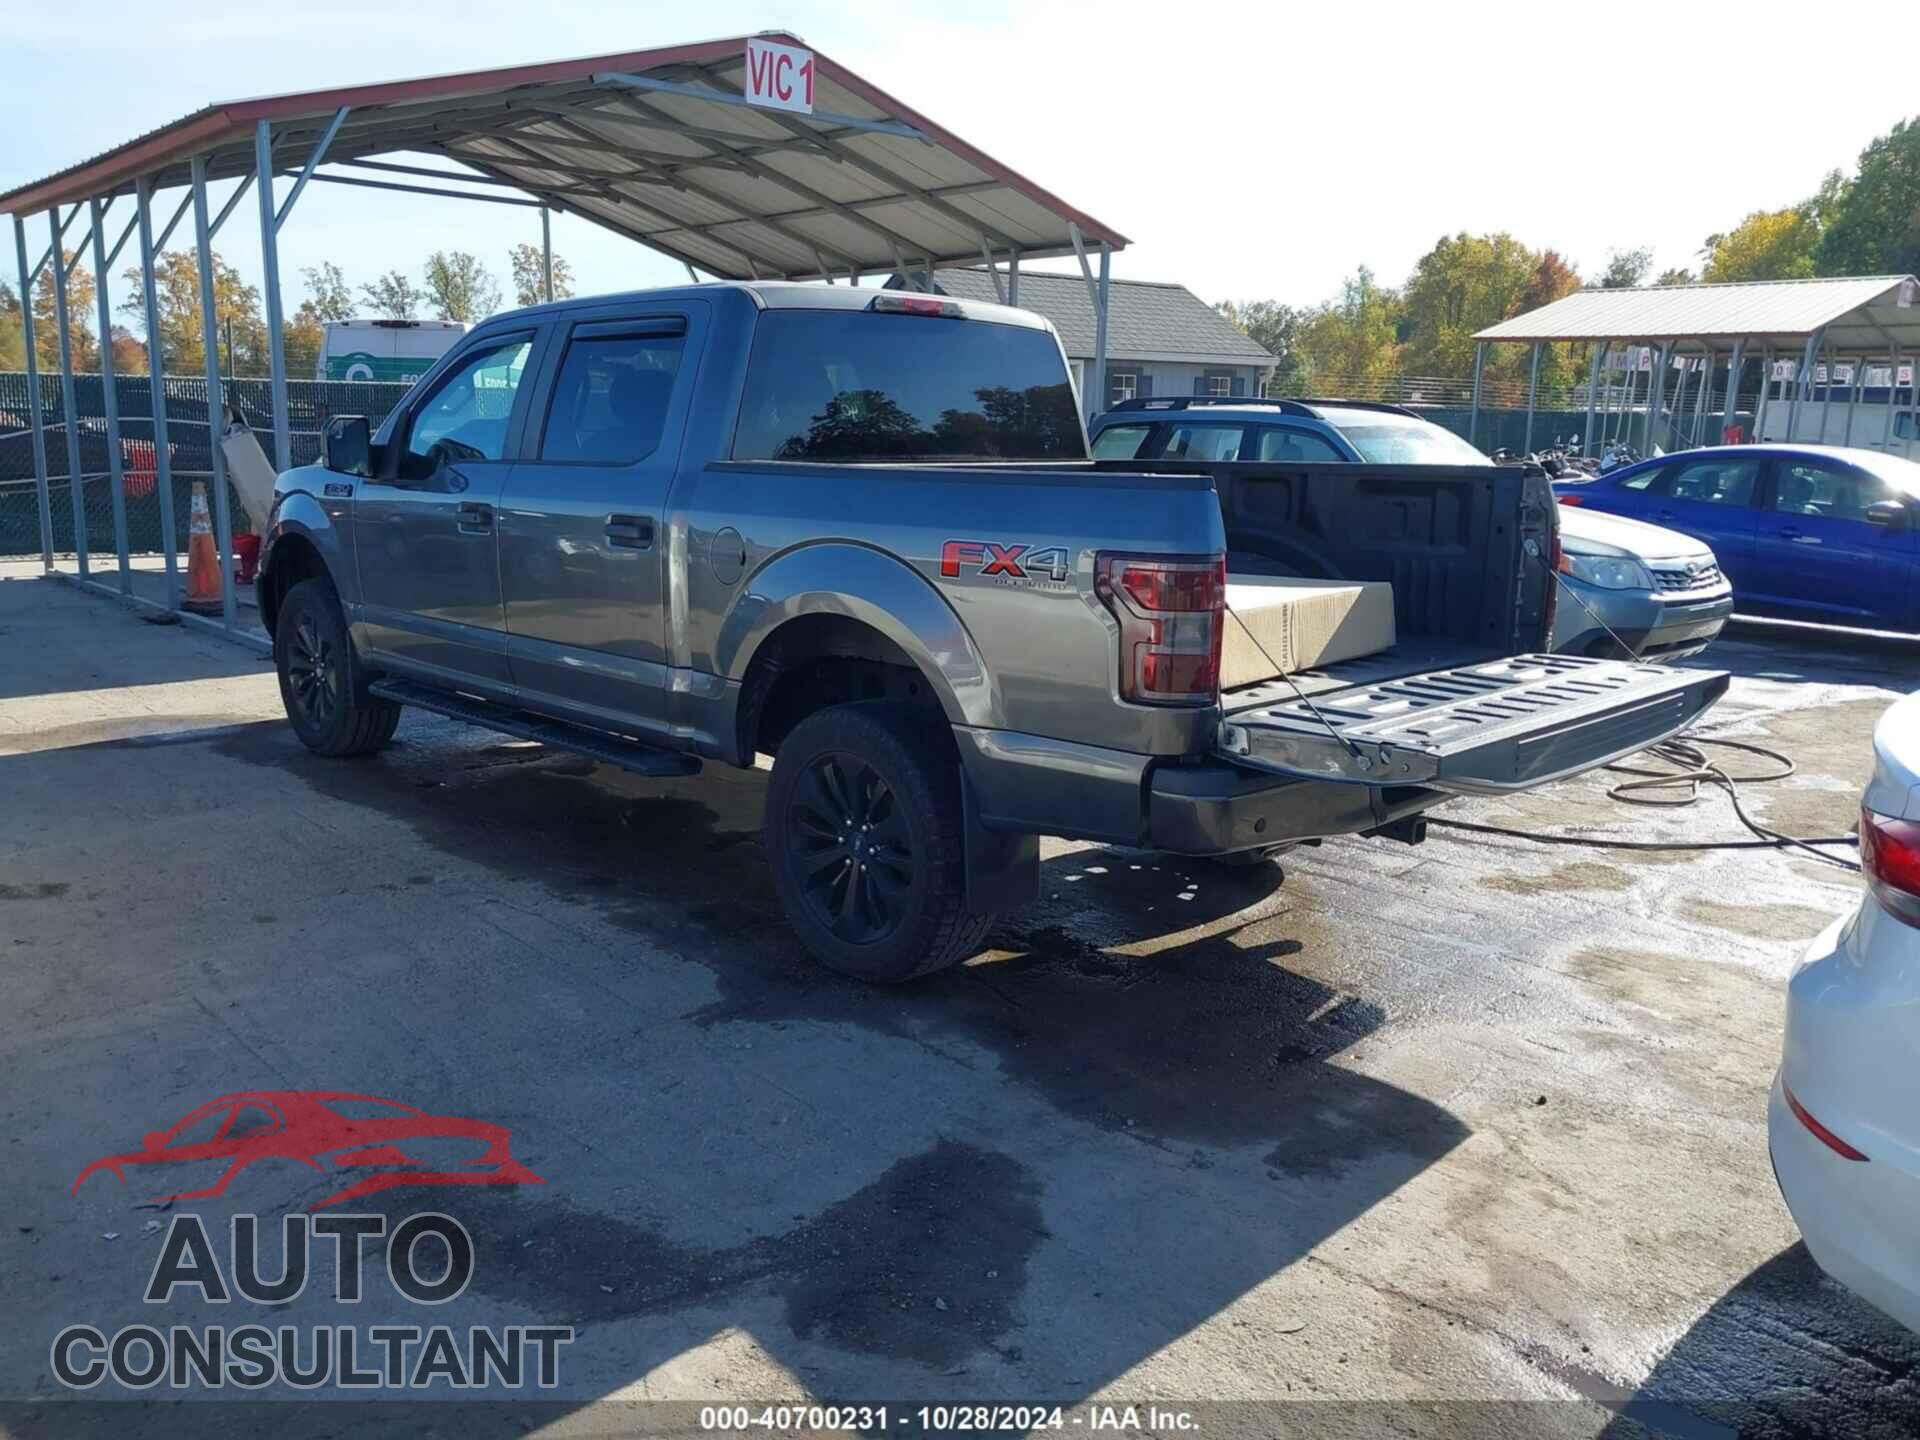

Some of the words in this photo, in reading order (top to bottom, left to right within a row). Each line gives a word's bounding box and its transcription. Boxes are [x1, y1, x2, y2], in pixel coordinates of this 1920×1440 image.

[748, 47, 793, 102] VIC
[799, 58, 813, 106] 1
[941, 538, 1069, 581] FX4
